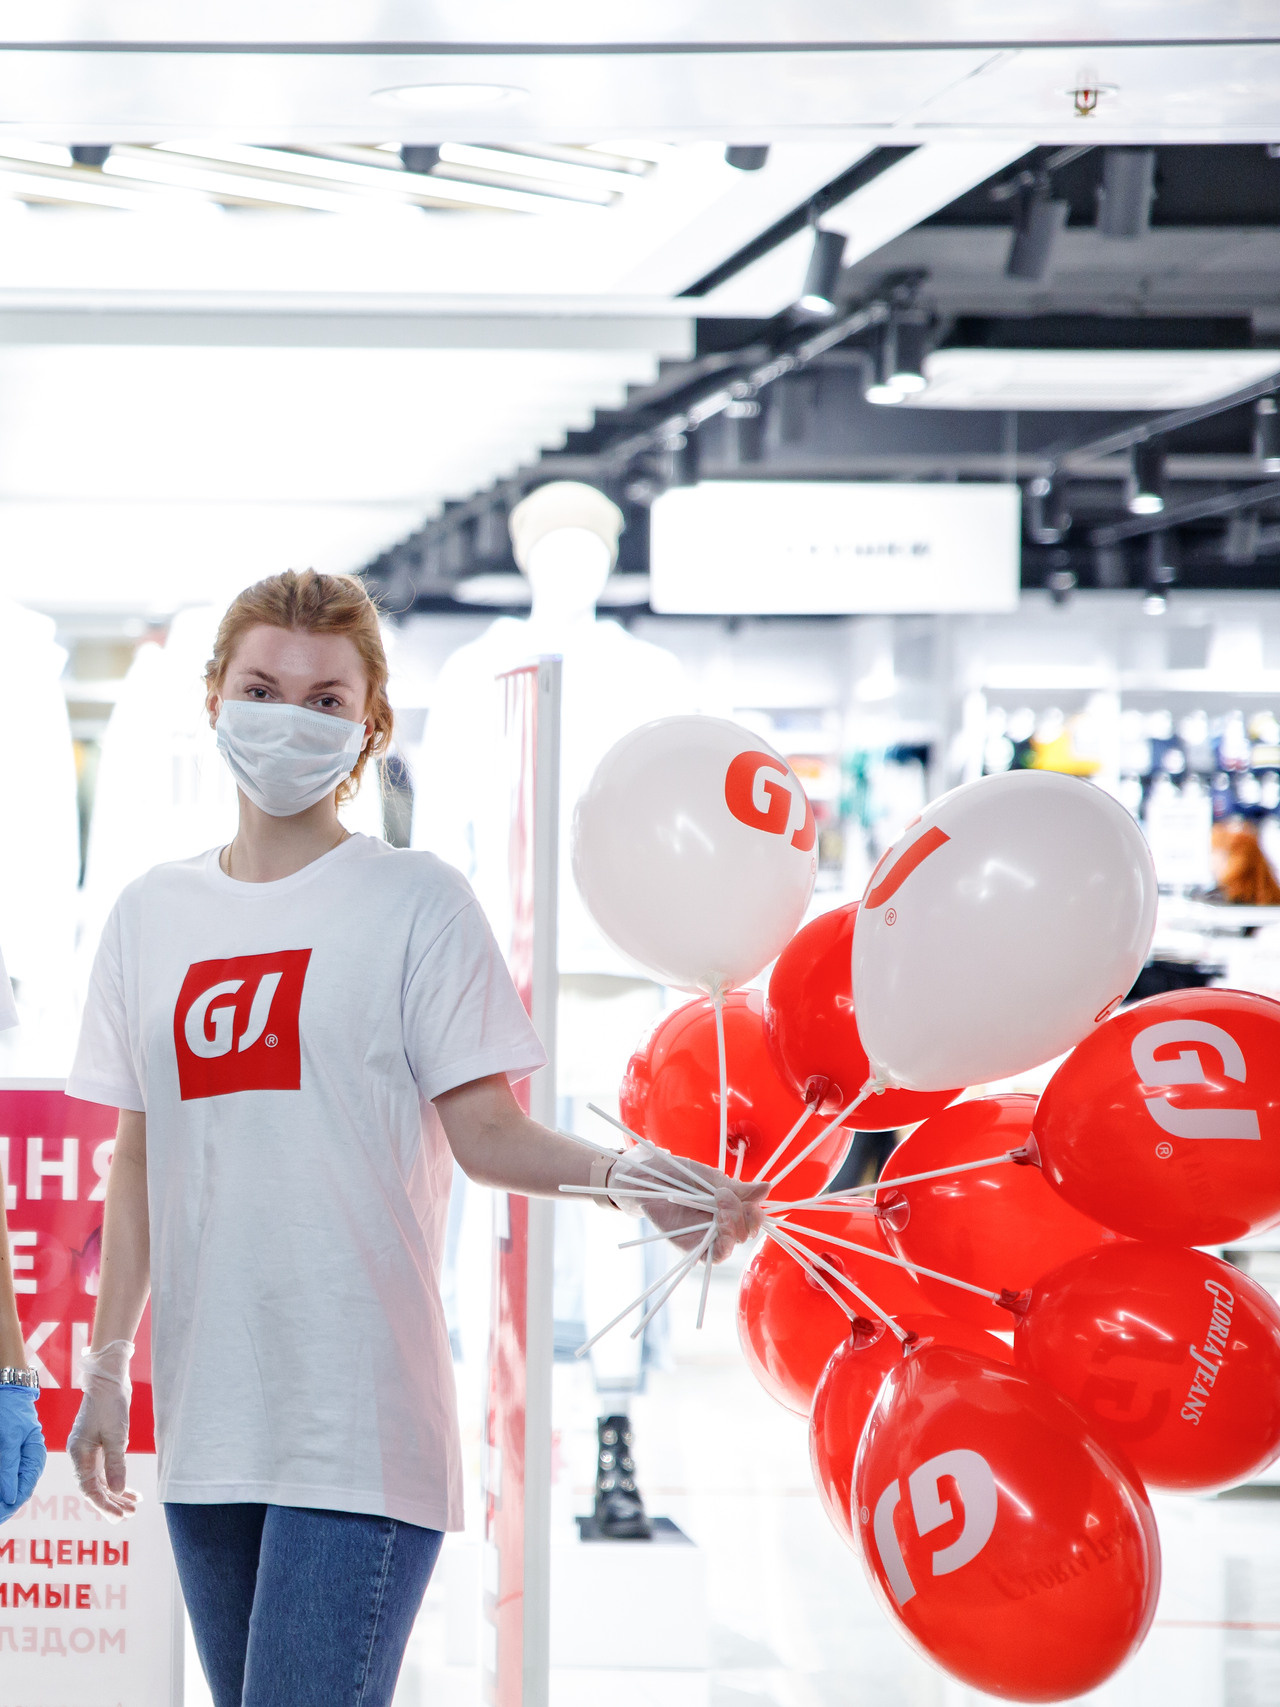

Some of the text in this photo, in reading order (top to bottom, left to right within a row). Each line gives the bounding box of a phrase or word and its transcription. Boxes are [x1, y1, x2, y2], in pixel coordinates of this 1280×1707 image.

[184, 972, 283, 1059] GJ
[1131, 1019, 1262, 1141] GJ
[1180, 1279, 1235, 1426] GLORIA JEANS
[29, 1539, 130, 1569] ЦЕНЫ
[873, 1448, 998, 1607] GJ
